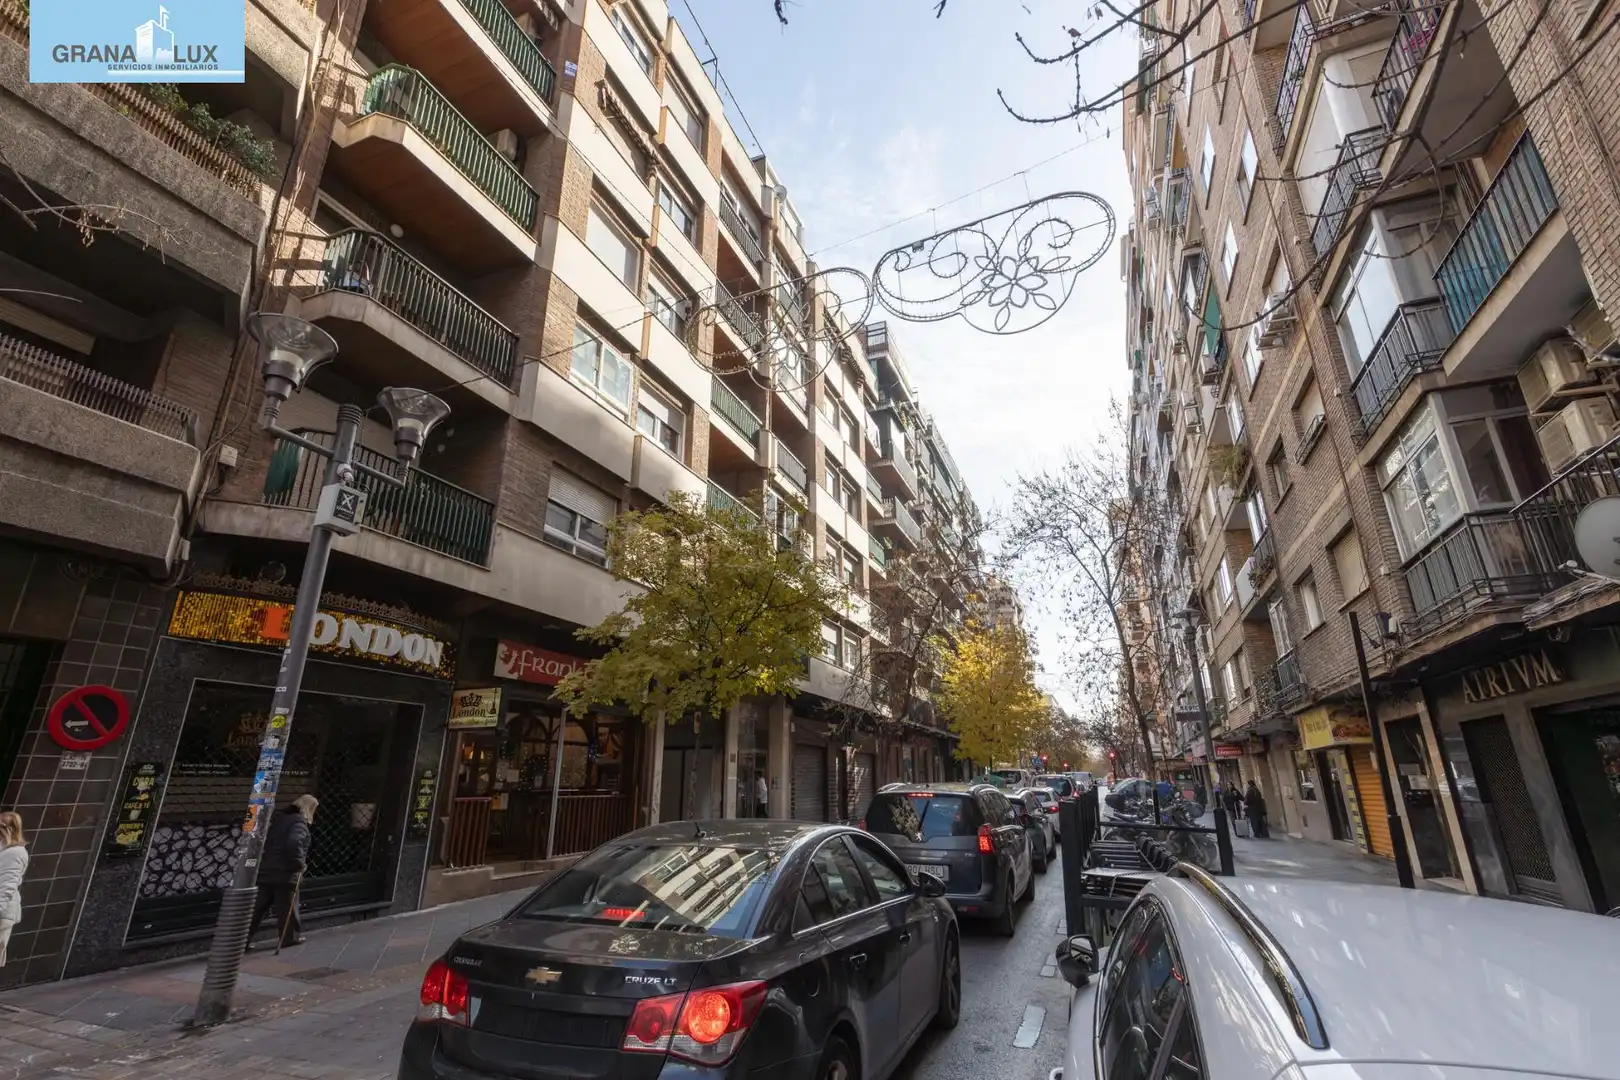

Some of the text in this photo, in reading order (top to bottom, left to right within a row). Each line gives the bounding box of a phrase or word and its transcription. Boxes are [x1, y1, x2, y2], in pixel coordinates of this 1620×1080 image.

[260, 606, 444, 668] LONDON
[1461, 647, 1561, 704] ATRIVM
[452, 706, 487, 718] London
[625, 976, 677, 986] CRUZE LT
